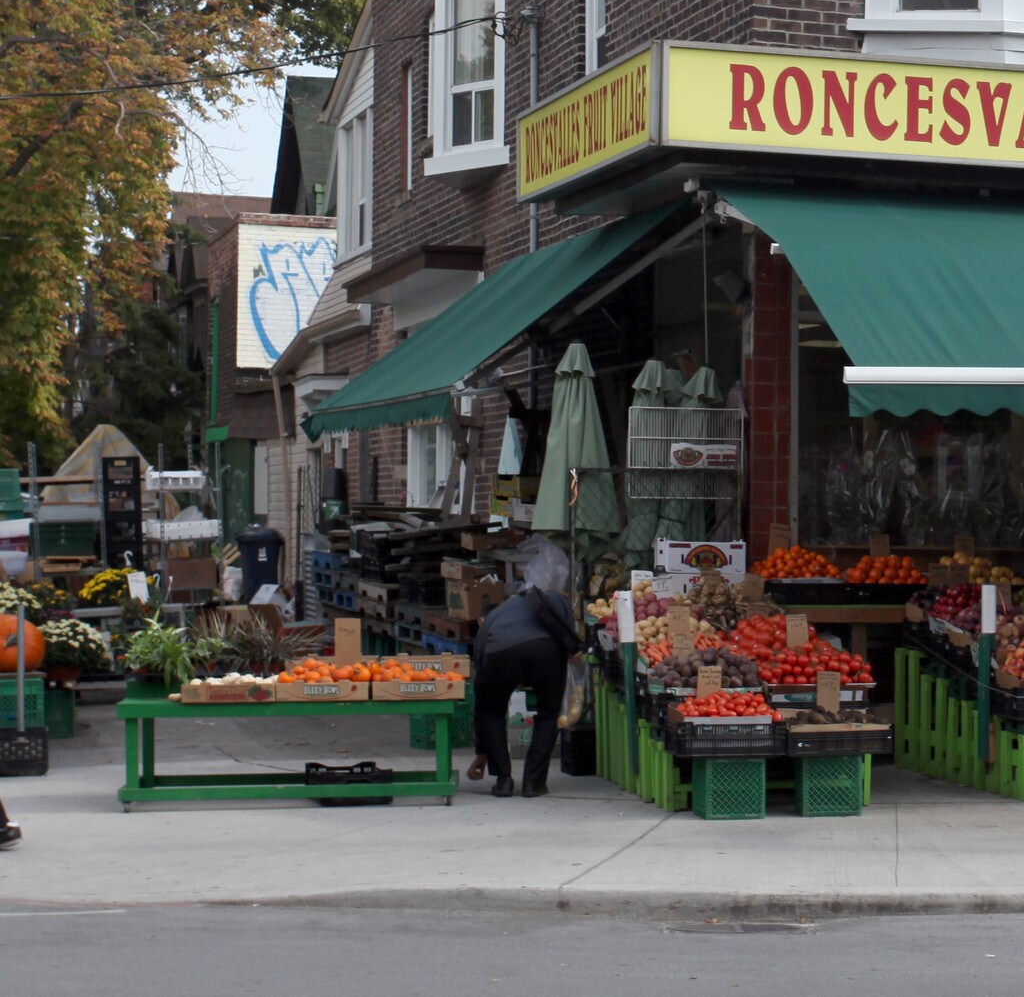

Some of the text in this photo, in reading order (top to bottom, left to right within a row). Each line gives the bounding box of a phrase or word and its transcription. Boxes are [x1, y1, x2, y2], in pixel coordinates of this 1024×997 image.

[525, 64, 647, 184] RONCESVALLES FRUIT VILLAGE
